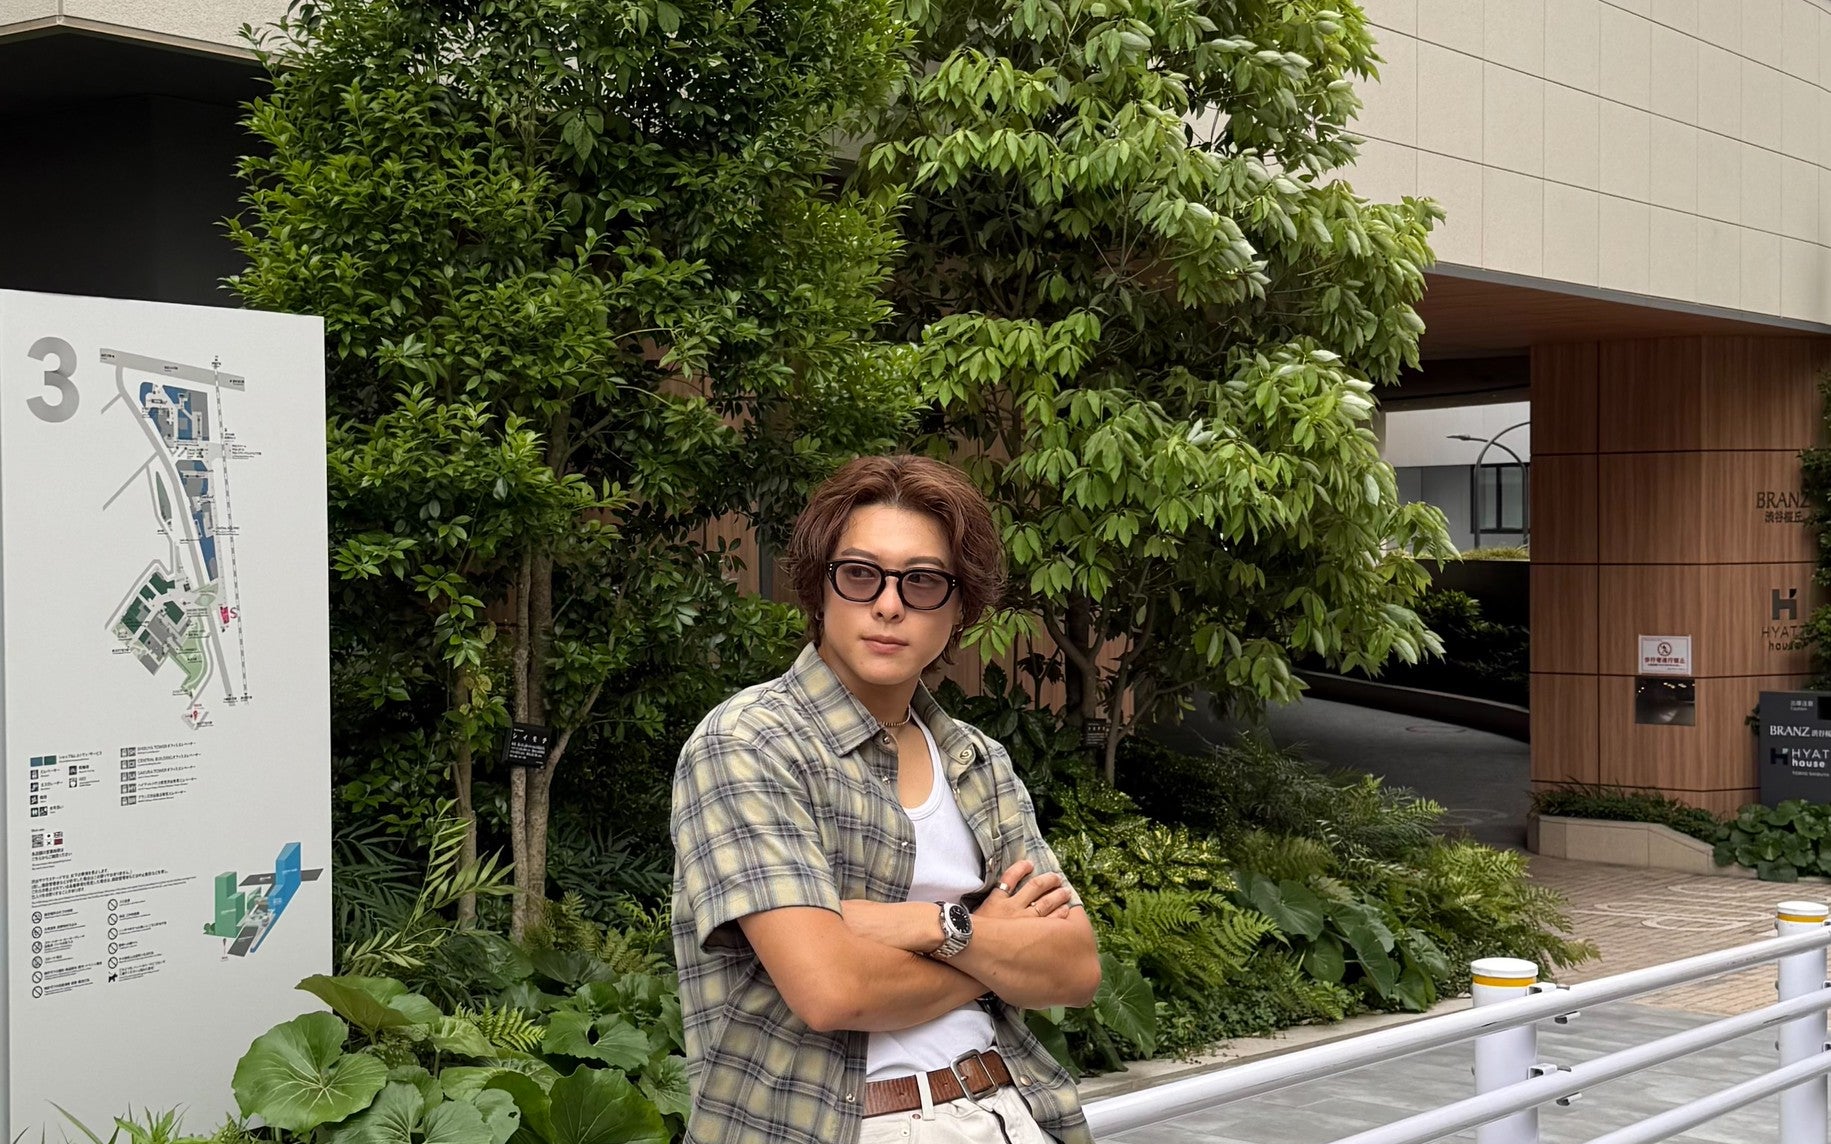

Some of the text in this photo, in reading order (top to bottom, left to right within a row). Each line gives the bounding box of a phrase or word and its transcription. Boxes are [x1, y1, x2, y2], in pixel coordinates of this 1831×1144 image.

[26, 336, 80, 423] 3
[1756, 491, 1810, 509] BRANZ
[1761, 626, 1806, 638] HYAT
[1769, 725, 1811, 737] BRANZ
[1791, 758, 1826, 768] house
